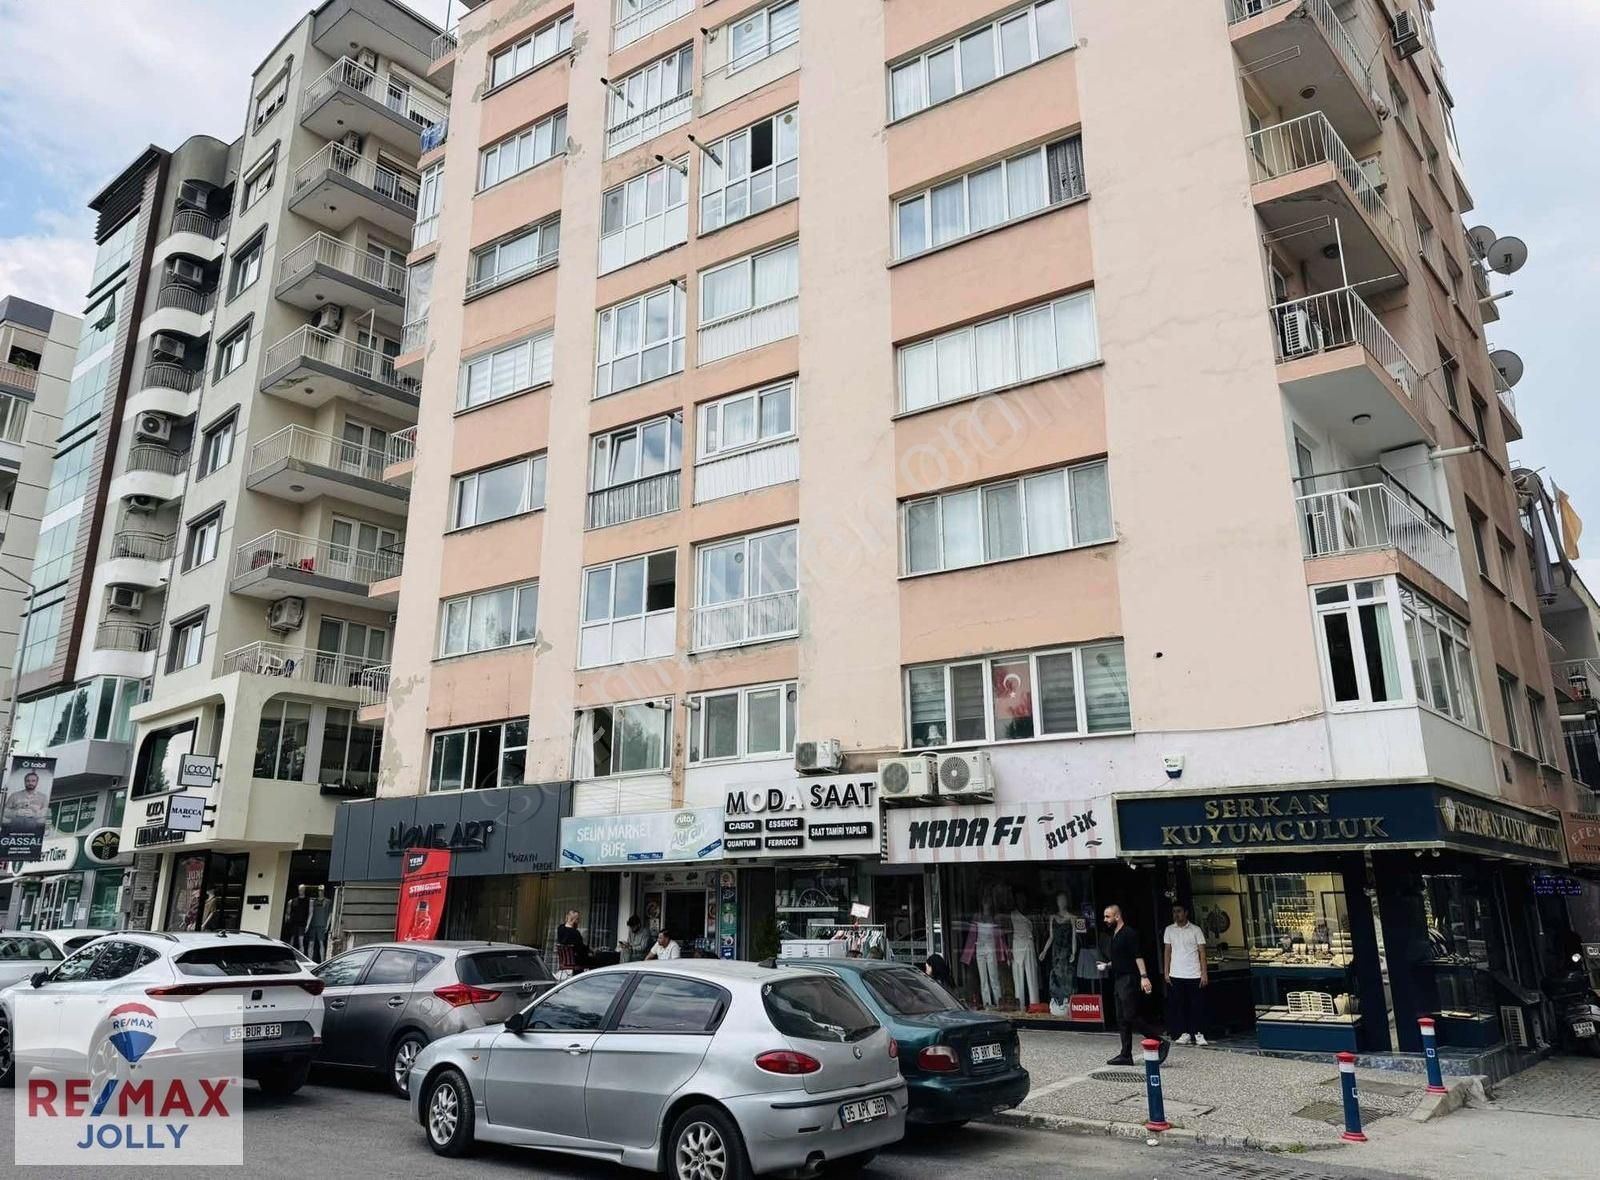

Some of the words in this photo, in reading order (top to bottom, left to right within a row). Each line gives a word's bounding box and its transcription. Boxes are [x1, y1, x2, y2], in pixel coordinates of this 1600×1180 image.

[725, 788, 804, 815] MODA
[810, 781, 876, 809] SAAT
[172, 807, 202, 816] MARCCA
[1205, 794, 1330, 819] SERKAN
[728, 821, 755, 830] CASIO
[768, 820, 799, 829] ESSENCE
[810, 827, 825, 837] SAAT
[908, 818, 989, 849] MODA
[1160, 817, 1389, 846] KUYUMCULUK
[0, 837, 42, 846] GASSAL
[726, 839, 756, 848] QUANTUM
[1071, 1003, 1100, 1013] İNDİRİM
[231, 1028, 243, 1038] 35
[245, 1026, 262, 1037] BUR
[265, 1025, 281, 1036] 833
[845, 1105, 856, 1121] 35
